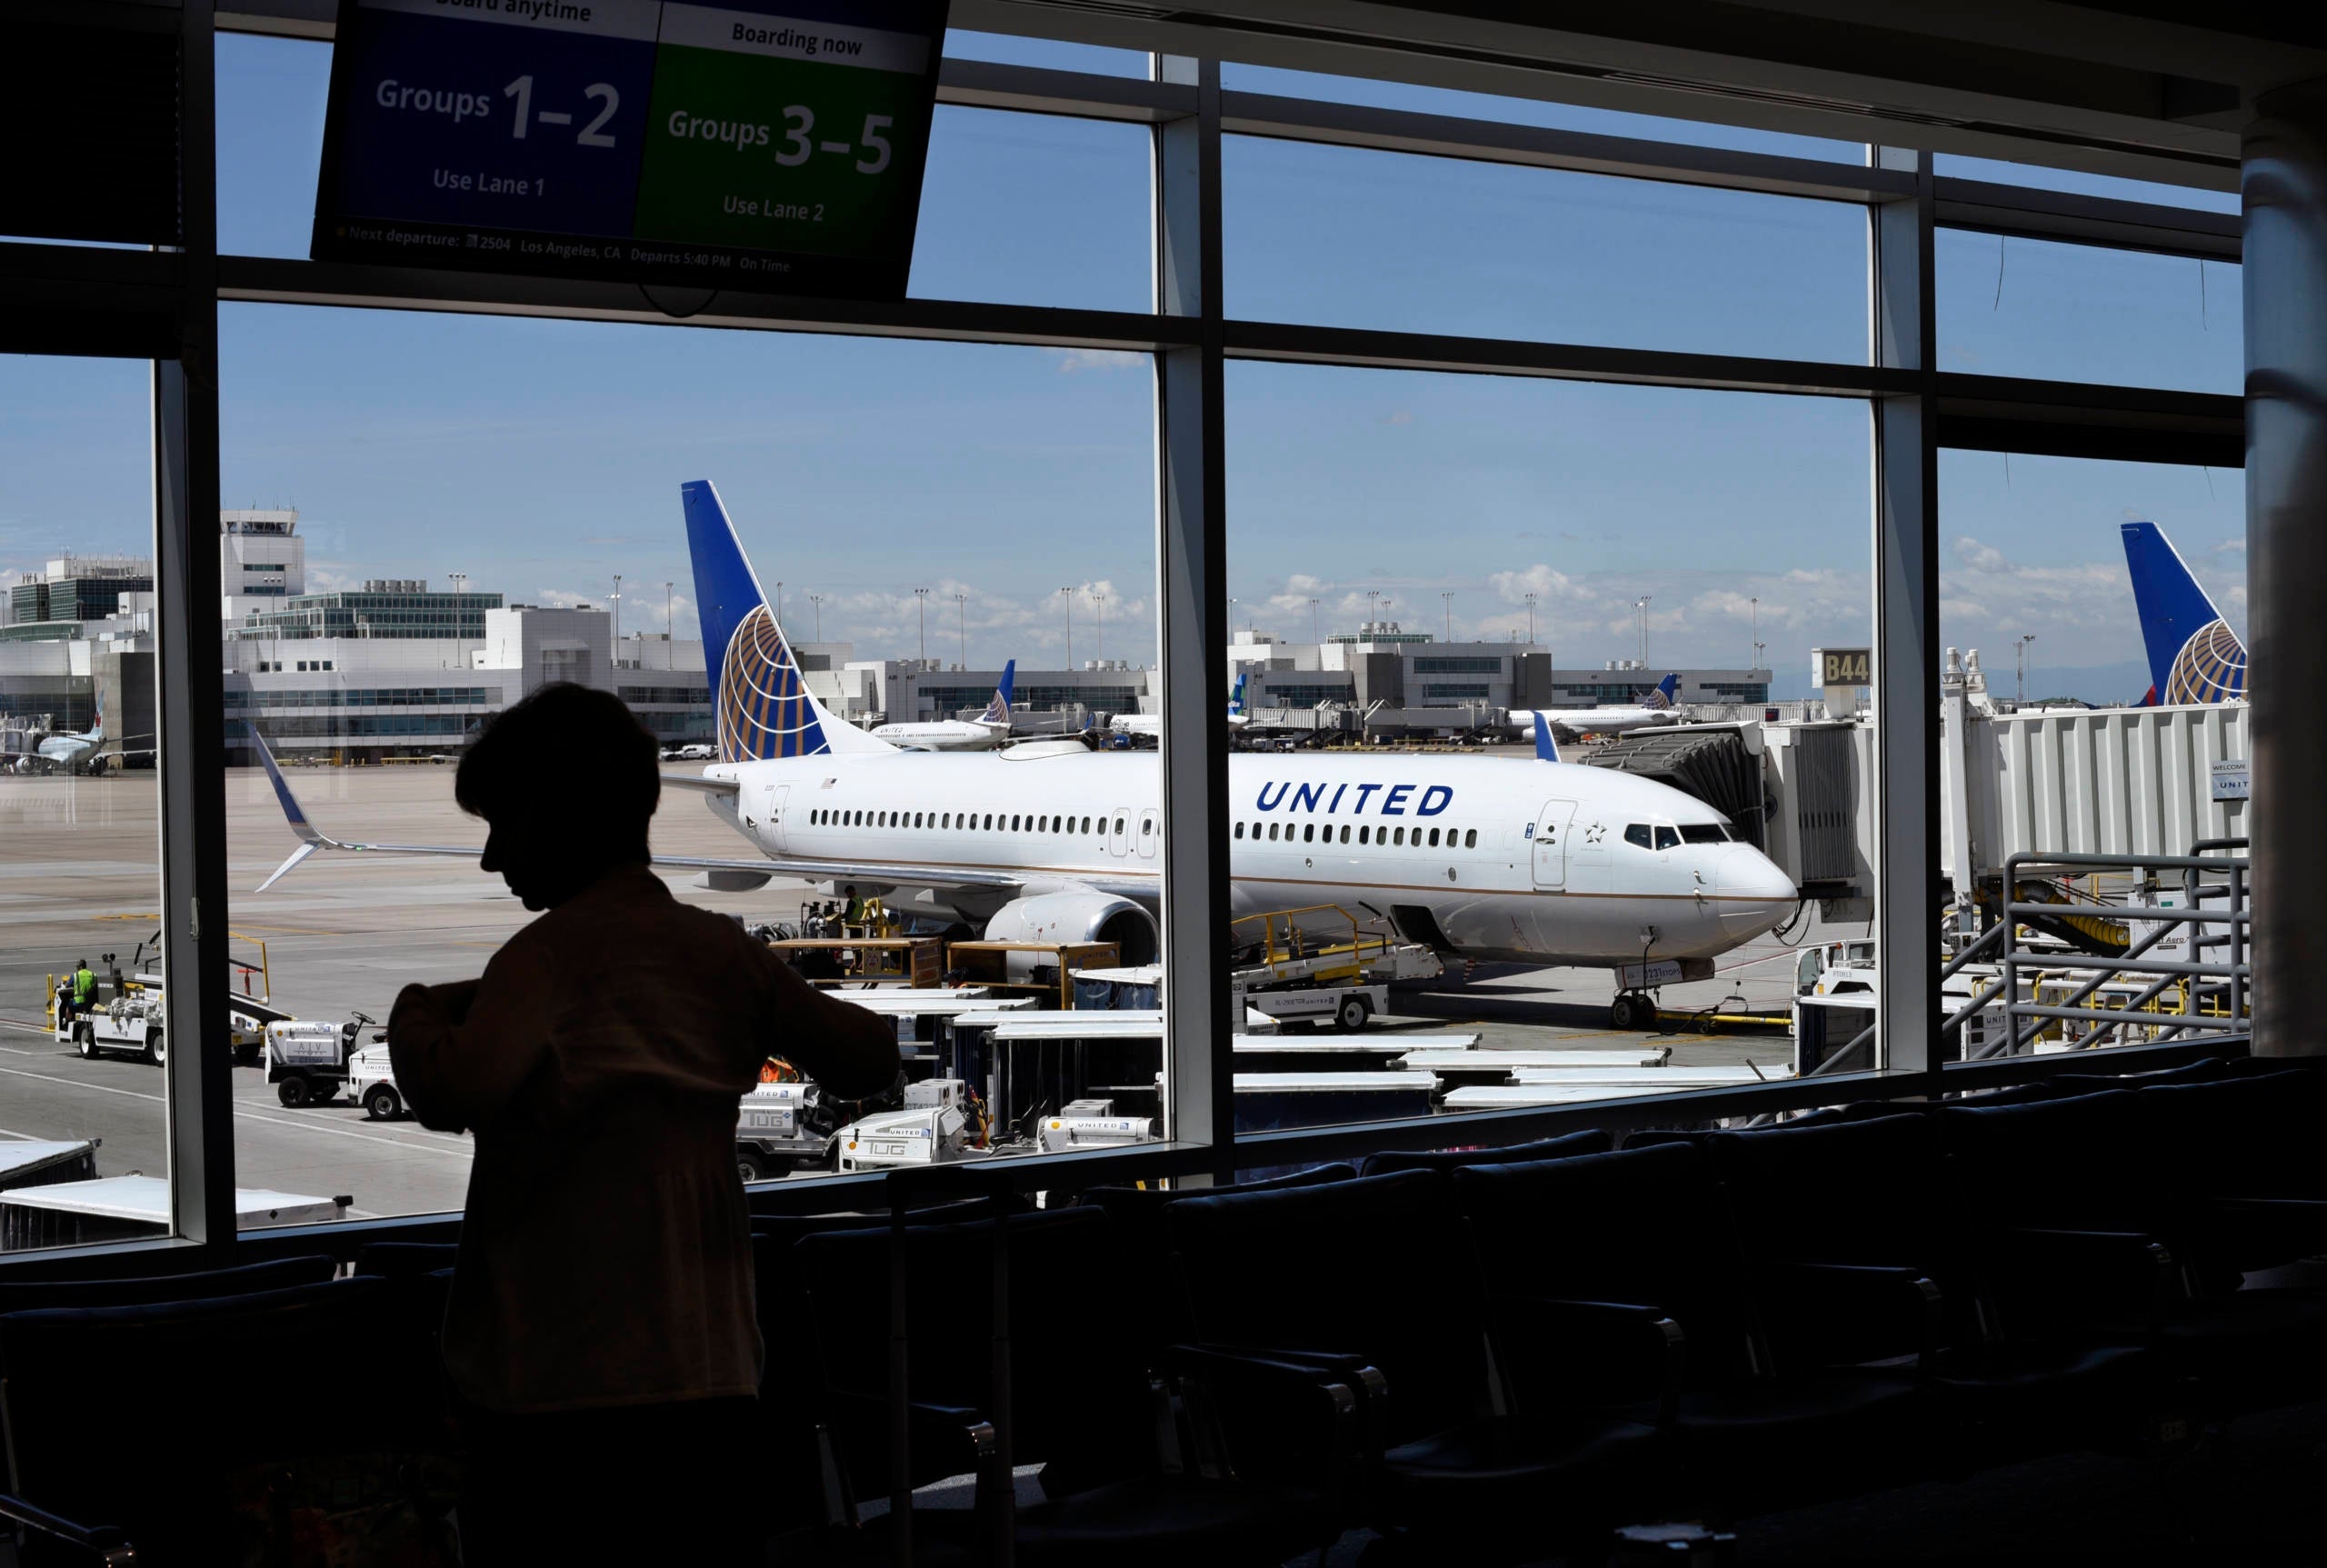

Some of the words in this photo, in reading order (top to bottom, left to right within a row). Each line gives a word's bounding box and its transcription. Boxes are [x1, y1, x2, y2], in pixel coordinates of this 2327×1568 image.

[504, 0, 591, 22] anytime
[731, 23, 817, 55] Boarding
[823, 39, 863, 55] now
[376, 79, 491, 123] Groups
[668, 110, 771, 152] Groups
[434, 169, 472, 189] Use
[477, 173, 529, 195] Lane
[534, 178, 544, 196] 1
[724, 195, 758, 215] Use
[764, 199, 808, 220] Lane
[813, 204, 824, 222] 2
[349, 226, 383, 241] Next
[386, 229, 460, 246] departure:
[479, 236, 511, 250] 2504
[521, 239, 543, 253] Los
[545, 242, 600, 259] Angeles,
[604, 247, 621, 259] CA
[631, 248, 681, 264] Departs
[684, 253, 709, 266] 5:40
[712, 254, 731, 267] PM
[740, 257, 757, 270] On
[761, 258, 791, 272] Time
[1825, 654, 1869, 681] B44
[1256, 782, 1453, 816] UNITED
[743, 1109, 783, 1126] TUG
[863, 1139, 909, 1155] TUG
